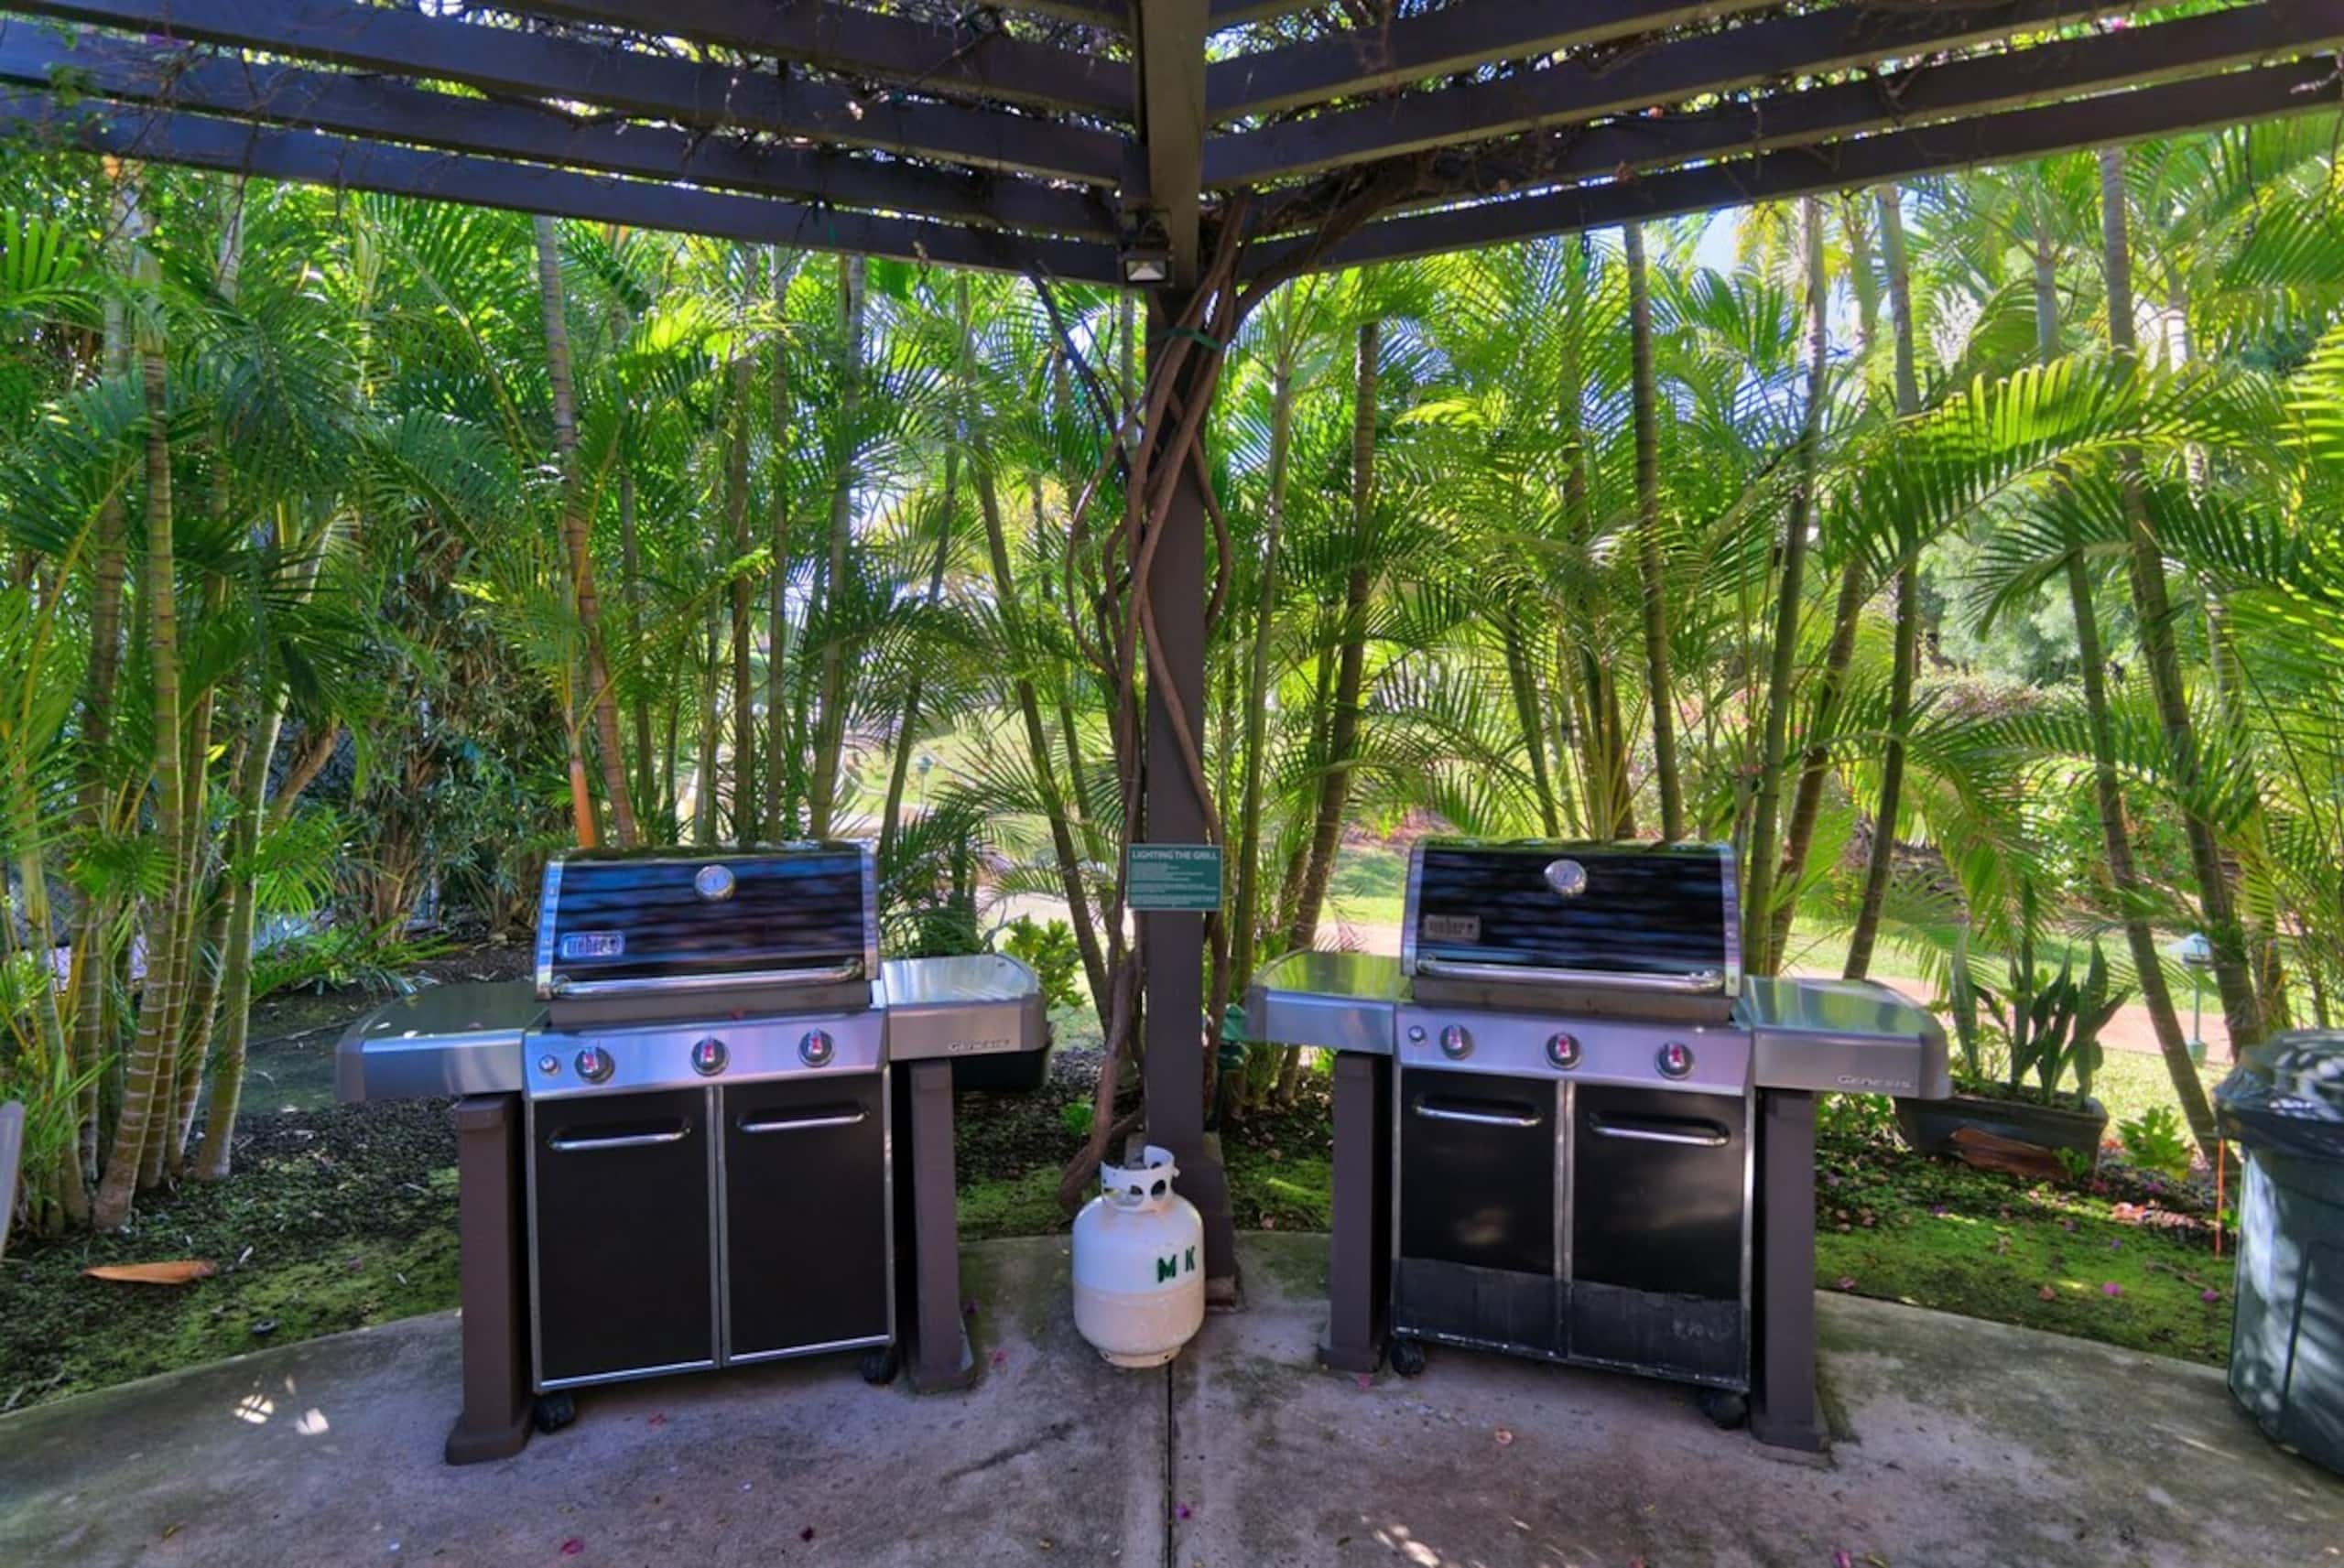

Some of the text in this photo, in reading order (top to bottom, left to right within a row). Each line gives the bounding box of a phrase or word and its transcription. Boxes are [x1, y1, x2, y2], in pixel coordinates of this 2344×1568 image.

[1132, 849, 1218, 860] LIGHTING THE GRILL
